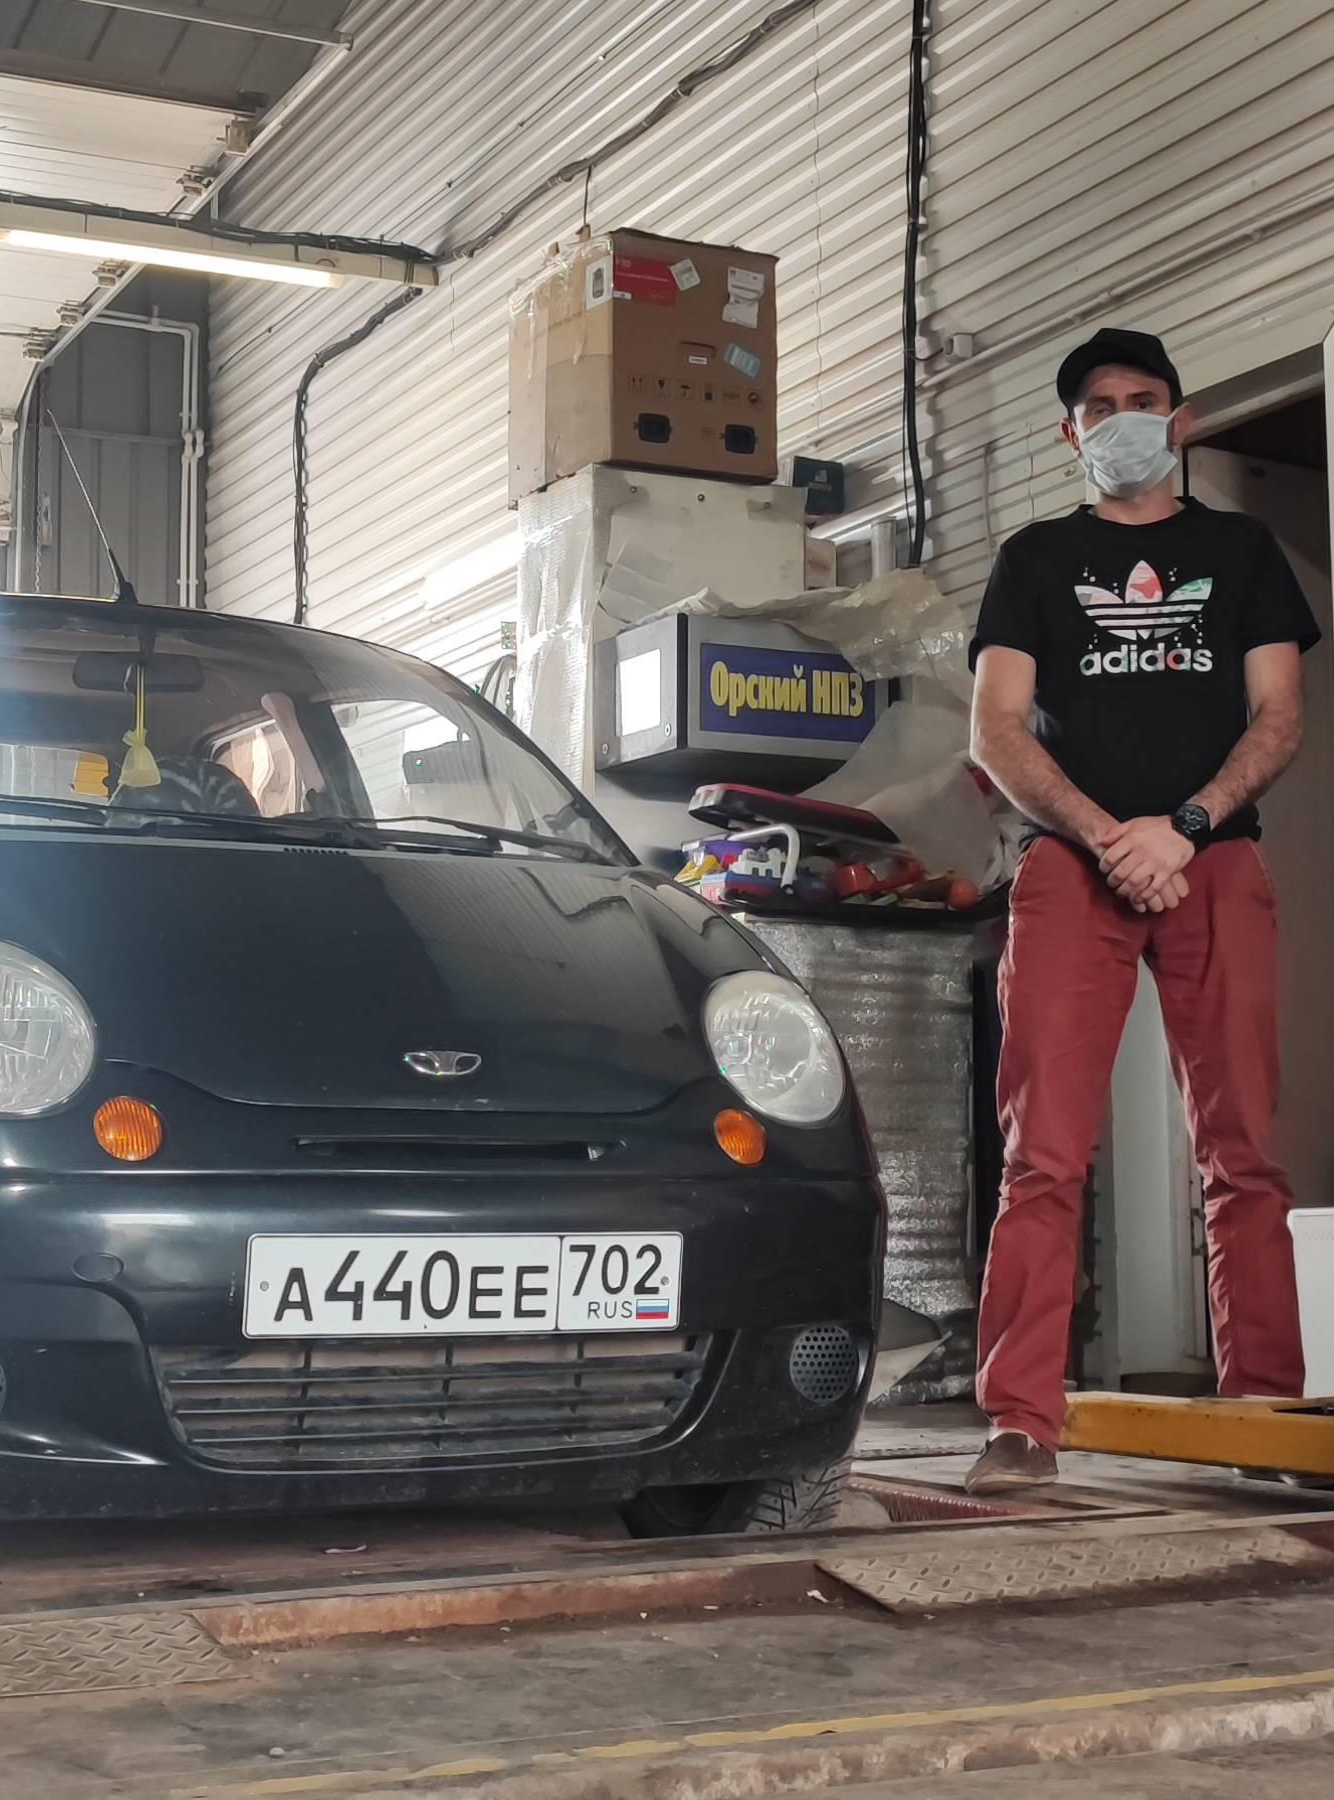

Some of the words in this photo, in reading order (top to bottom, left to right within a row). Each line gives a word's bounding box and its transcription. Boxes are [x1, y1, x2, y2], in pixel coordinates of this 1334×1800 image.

[1079, 642, 1213, 676] adidas
[710, 660, 807, 717] Орский
[812, 669, 864, 717] НПЗ
[569, 1244, 662, 1296] 702
[587, 1300, 633, 1320] RUS
